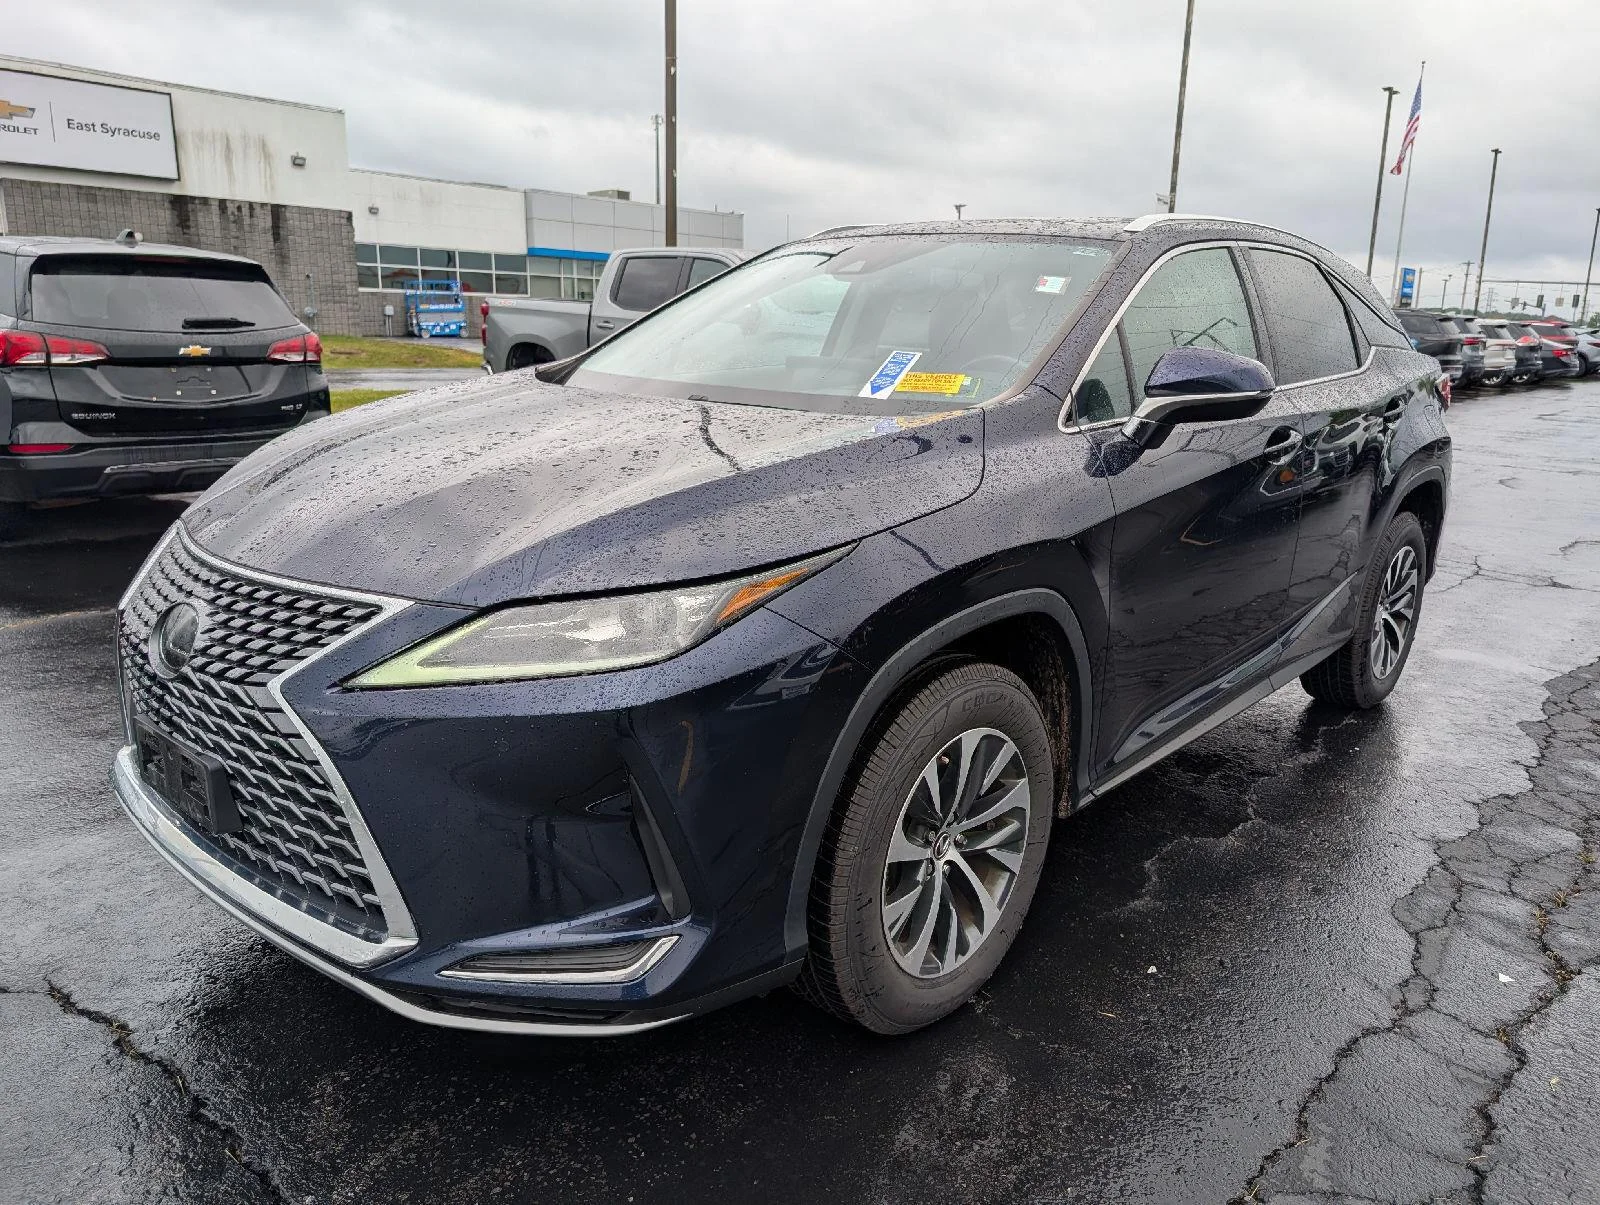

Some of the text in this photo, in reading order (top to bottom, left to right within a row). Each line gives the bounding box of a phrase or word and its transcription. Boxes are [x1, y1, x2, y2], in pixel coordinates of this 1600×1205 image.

[66, 118, 161, 141] East Syracuse
[71, 412, 117, 420] EQUINOX
